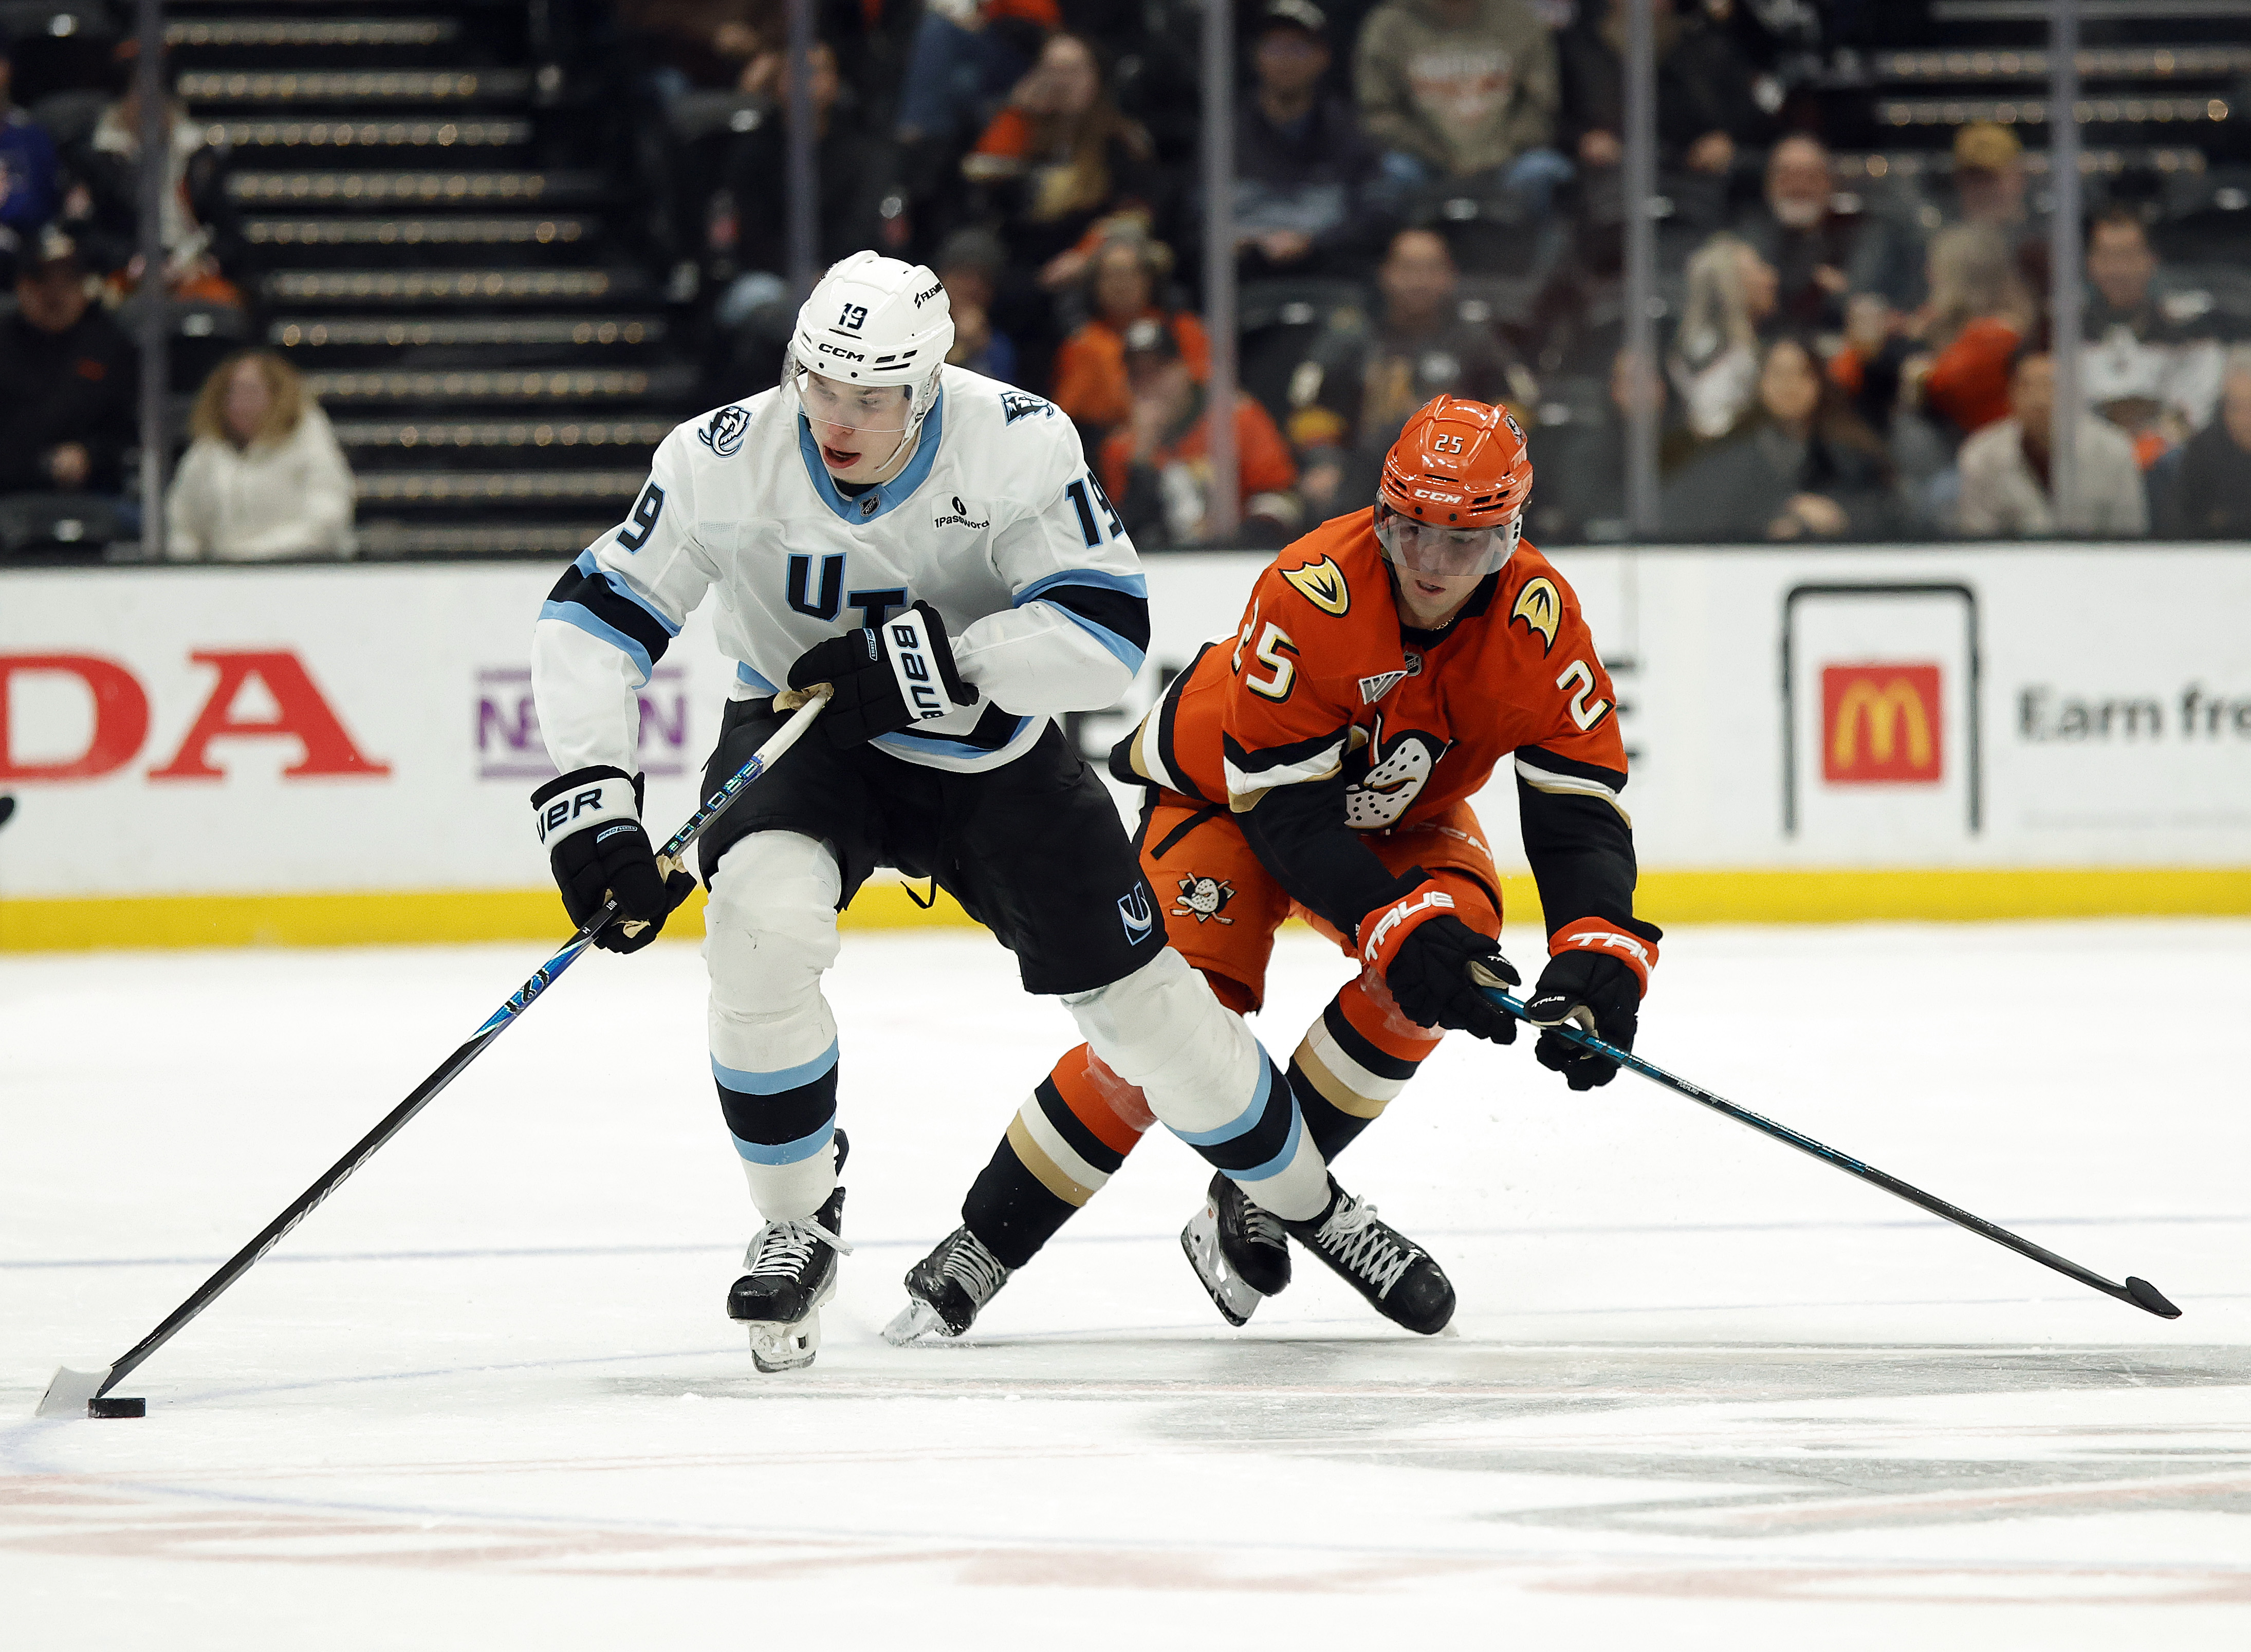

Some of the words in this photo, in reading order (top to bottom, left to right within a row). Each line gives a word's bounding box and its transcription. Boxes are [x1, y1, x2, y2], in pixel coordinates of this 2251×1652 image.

[838, 303, 868, 330] 19
[818, 343, 865, 362] CCM
[1434, 434, 1464, 454] 25
[1414, 488, 1463, 504] CCM
[934, 515, 990, 529] 1Password
[1556, 642, 1615, 731] 2
[2016, 681, 2162, 741] Earn
[1365, 891, 1455, 962] TRUE
[1531, 996, 1566, 1008] TRUE
